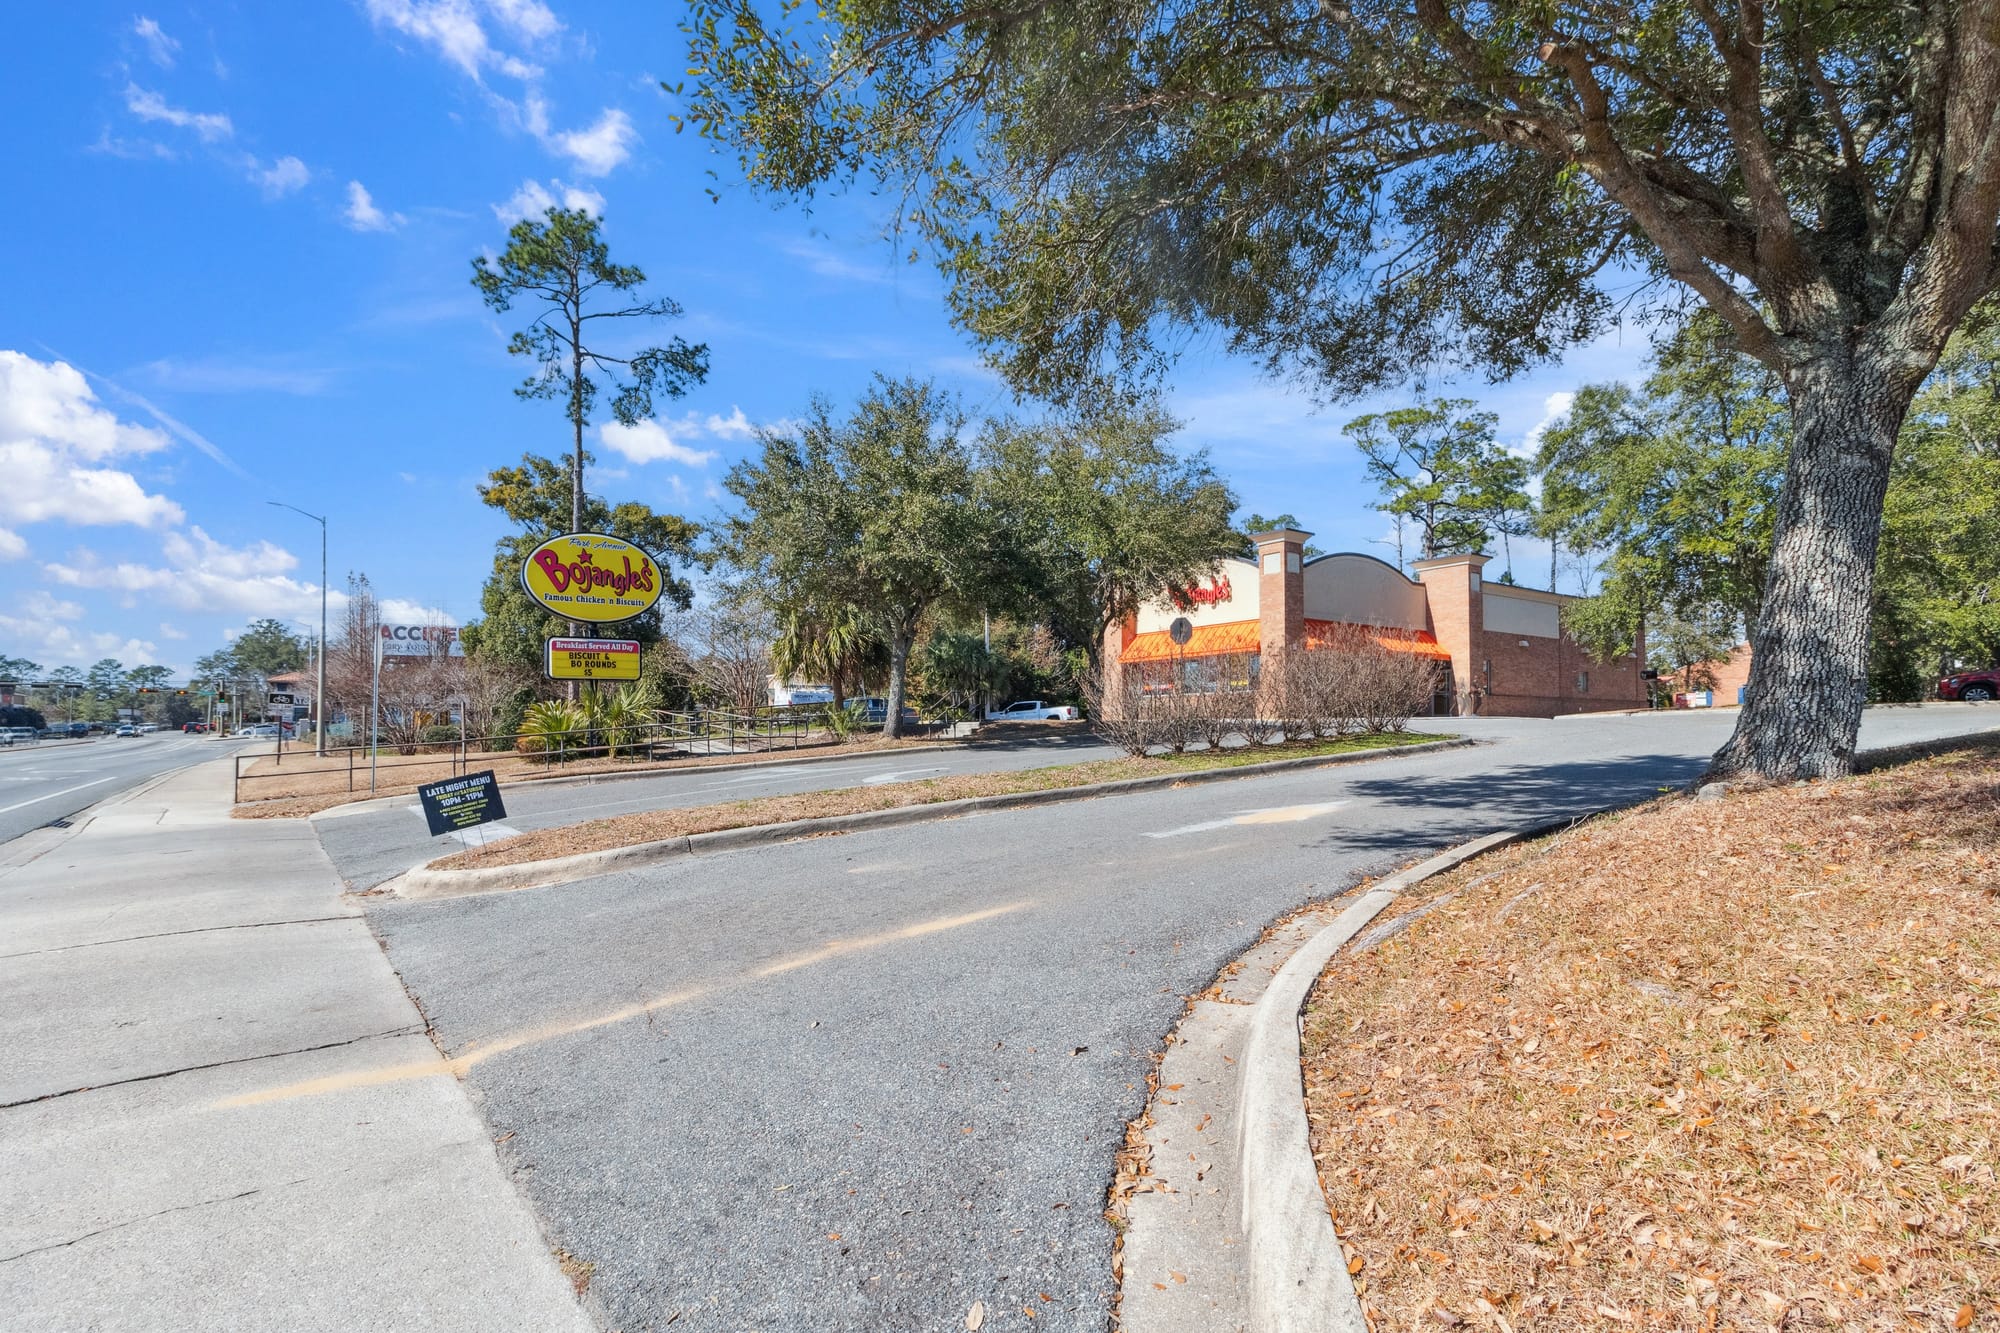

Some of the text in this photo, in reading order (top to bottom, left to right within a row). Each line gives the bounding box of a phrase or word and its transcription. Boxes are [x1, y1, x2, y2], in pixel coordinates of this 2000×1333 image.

[569, 537, 628, 551] Park Avenue
[544, 593, 573, 602] Famous
[576, 595, 605, 604] Chicken
[616, 597, 645, 607] Biscuits
[556, 641, 588, 649] Breakfast
[589, 642, 610, 650] Served
[621, 643, 634, 652] Day
[569, 652, 600, 660] BISCUIT
[571, 660, 617, 669] BO ROUNDS
[584, 669, 593, 677] $5
[426, 775, 491, 797] LATE NIGHT MENU
[435, 792, 454, 800] FRIDAY
[459, 785, 485, 795] SATURDAY
[441, 797, 461, 807] 10PM
[466, 791, 484, 800] 11PM
